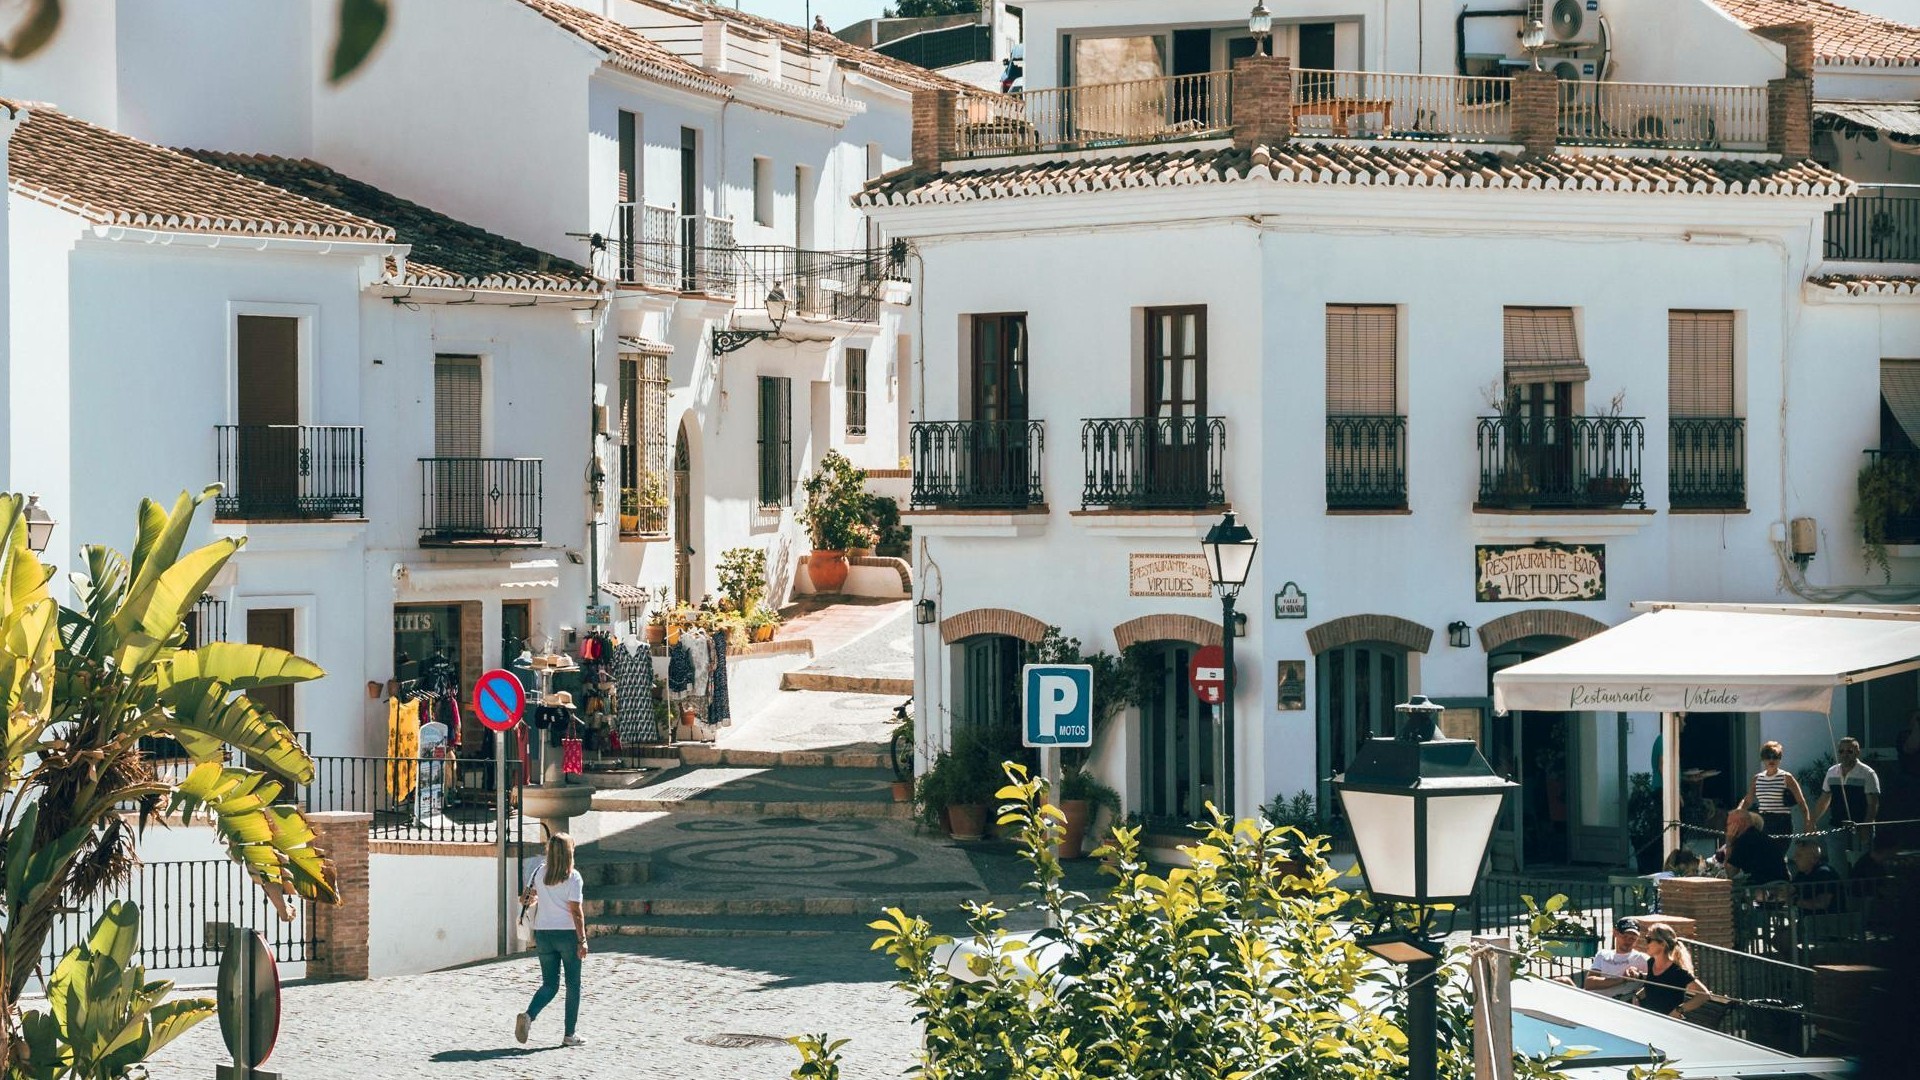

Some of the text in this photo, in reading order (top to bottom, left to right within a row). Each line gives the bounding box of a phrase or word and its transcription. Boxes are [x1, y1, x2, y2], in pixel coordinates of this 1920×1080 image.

[1147, 577, 1194, 592] VIRTUDES
[1505, 573, 1580, 598] VIRTUDES
[1039, 675, 1078, 736] P
[1570, 684, 1740, 710] Restaurante Virtudes
[1060, 725, 1086, 736] MOTOS
